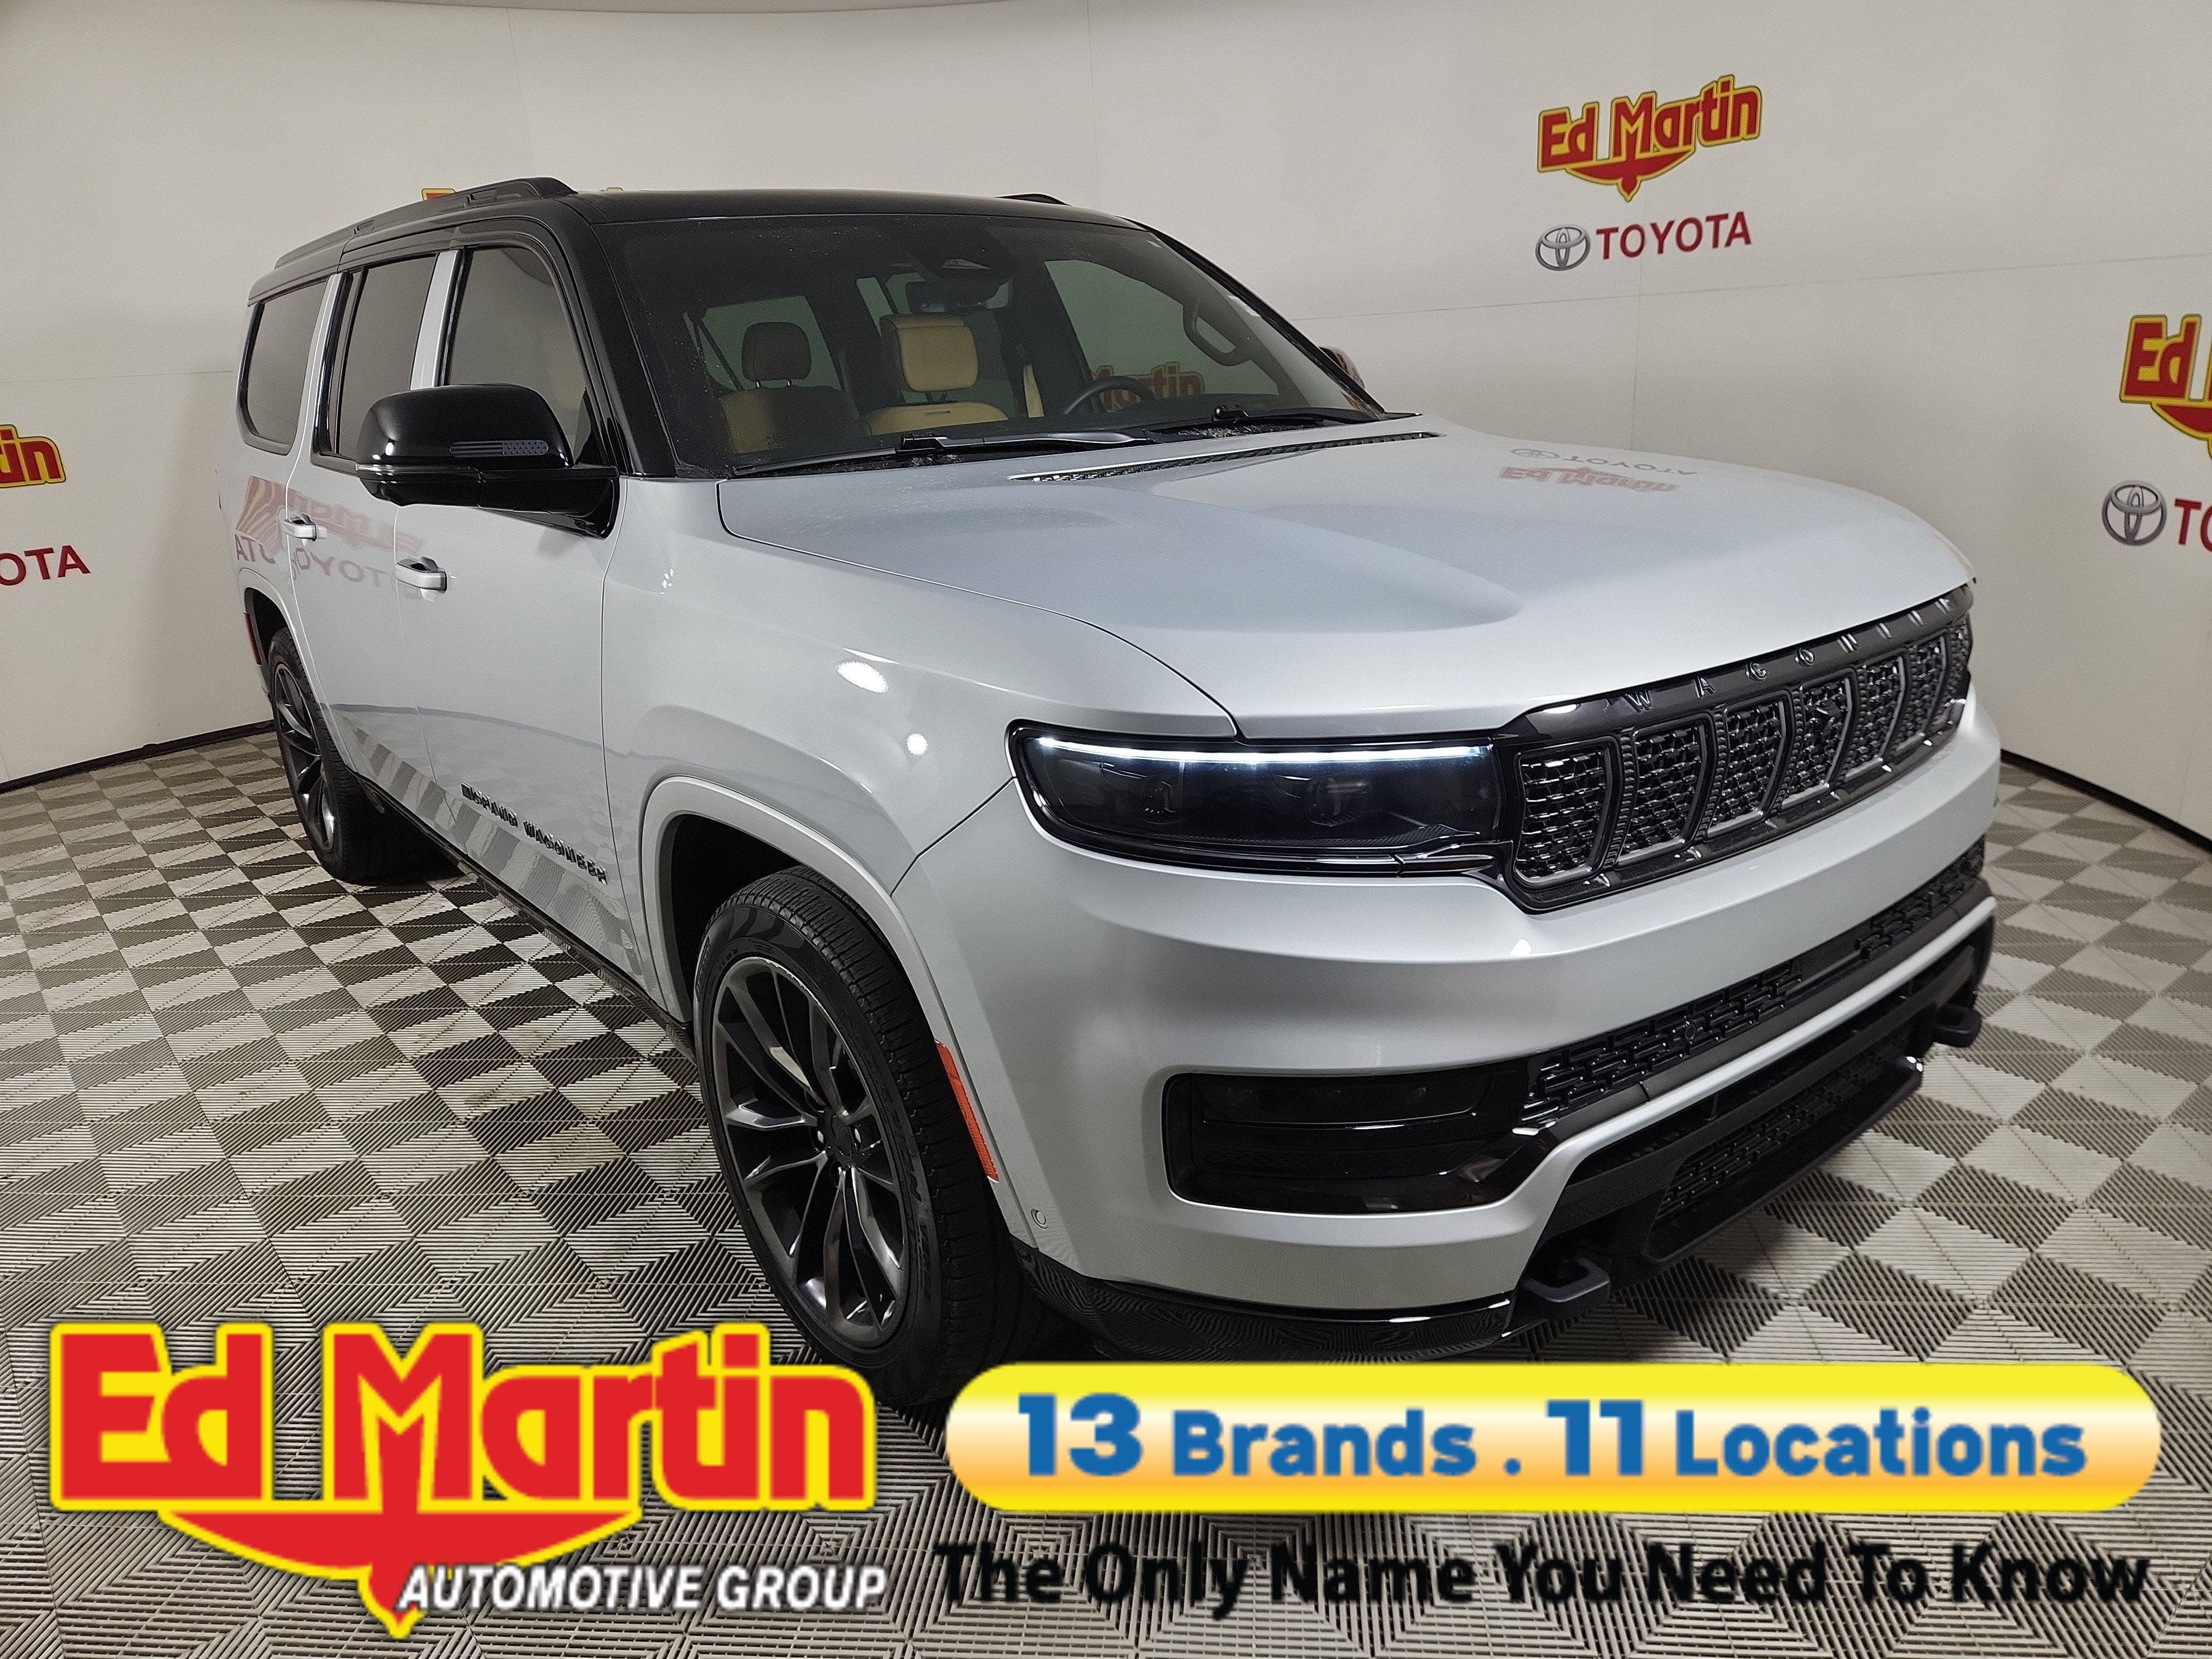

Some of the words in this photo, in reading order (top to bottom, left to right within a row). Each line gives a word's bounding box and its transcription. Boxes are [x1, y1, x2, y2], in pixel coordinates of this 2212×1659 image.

[1538, 102, 1599, 172] Ed
[1608, 74, 1762, 164] Martin
[1596, 211, 1751, 260] TOYOTA
[1092, 362, 1204, 413] tin
[2120, 314, 2201, 403] Ed
